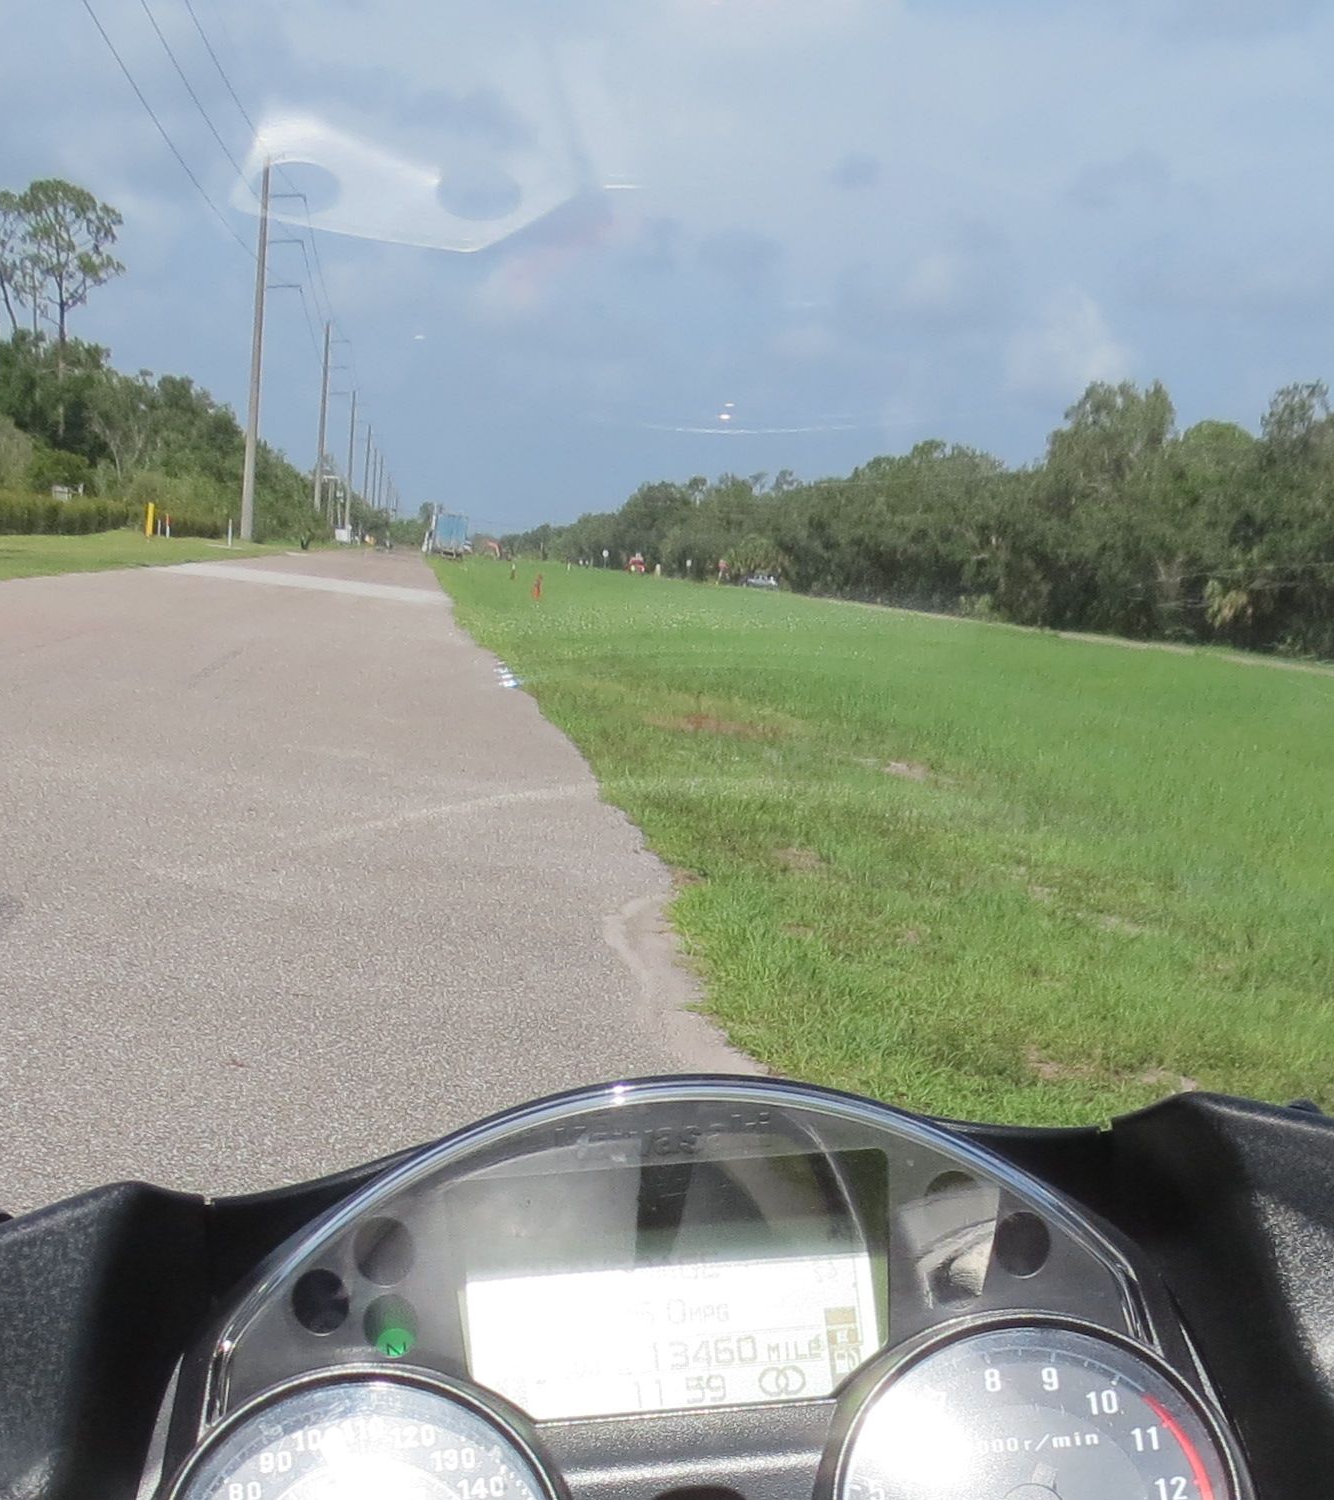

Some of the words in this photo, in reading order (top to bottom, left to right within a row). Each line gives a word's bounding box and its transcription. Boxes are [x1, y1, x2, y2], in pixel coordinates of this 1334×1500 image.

[984, 1368, 1002, 1393] 8
[1041, 1366, 1060, 1391] 9
[1085, 1389, 1119, 1415] 10
[391, 1424, 437, 1450] 120
[1131, 1426, 1161, 1452] 11
[258, 1450, 293, 1475] 90
[430, 1447, 477, 1473] 130
[457, 1475, 506, 1500] 140
